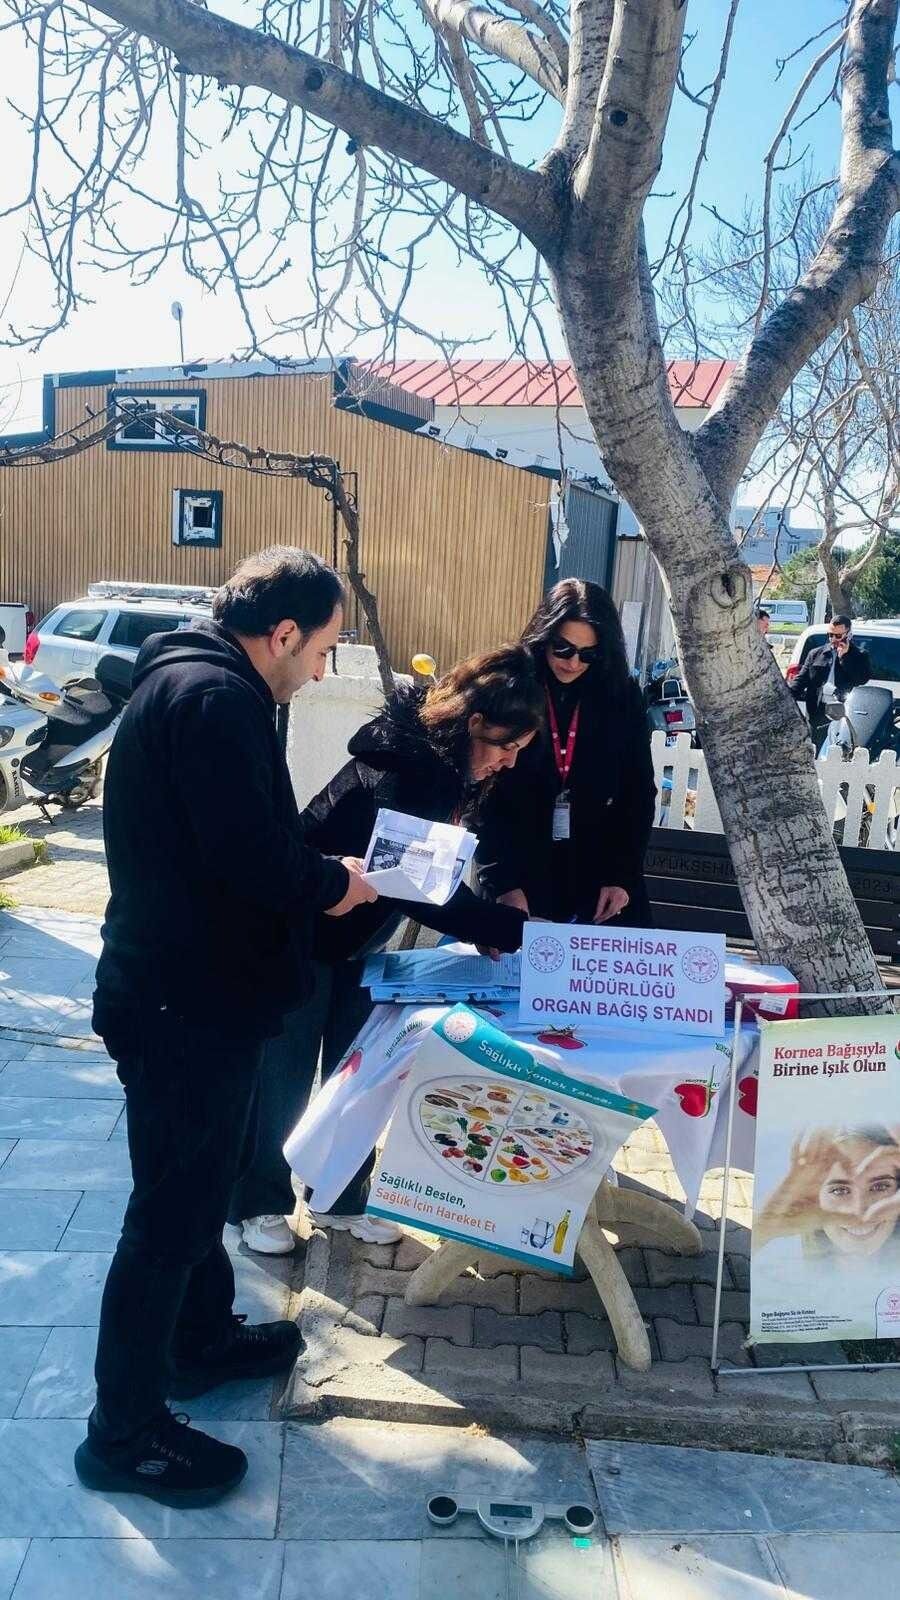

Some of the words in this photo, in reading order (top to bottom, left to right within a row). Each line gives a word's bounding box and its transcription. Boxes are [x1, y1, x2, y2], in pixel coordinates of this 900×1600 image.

[569, 936, 678, 957] SEFERİHİSAR
[572, 954, 608, 976] İLÇE
[613, 958, 675, 978] SAĞLIK
[569, 976, 676, 999] MÜDÜRLÜĞÜ
[532, 997, 592, 1015] ORGAN
[597, 1000, 648, 1022] BAĞIŞ
[653, 1005, 713, 1024] STANDI
[478, 1039, 522, 1074] Sağlıklı
[774, 1046, 823, 1060] Kornea
[827, 1041, 887, 1059] Bağışıyla
[773, 1062, 819, 1077] Birine
[822, 1060, 850, 1077] Işık
[853, 1058, 887, 1073] Olun
[379, 1171, 423, 1194] Sağlıklı
[424, 1184, 467, 1209] Beslen,
[375, 1187, 411, 1208] Sağlık
[413, 1198, 434, 1214] İçin
[436, 1204, 481, 1230] Hareket
[484, 1220, 497, 1233] Et
